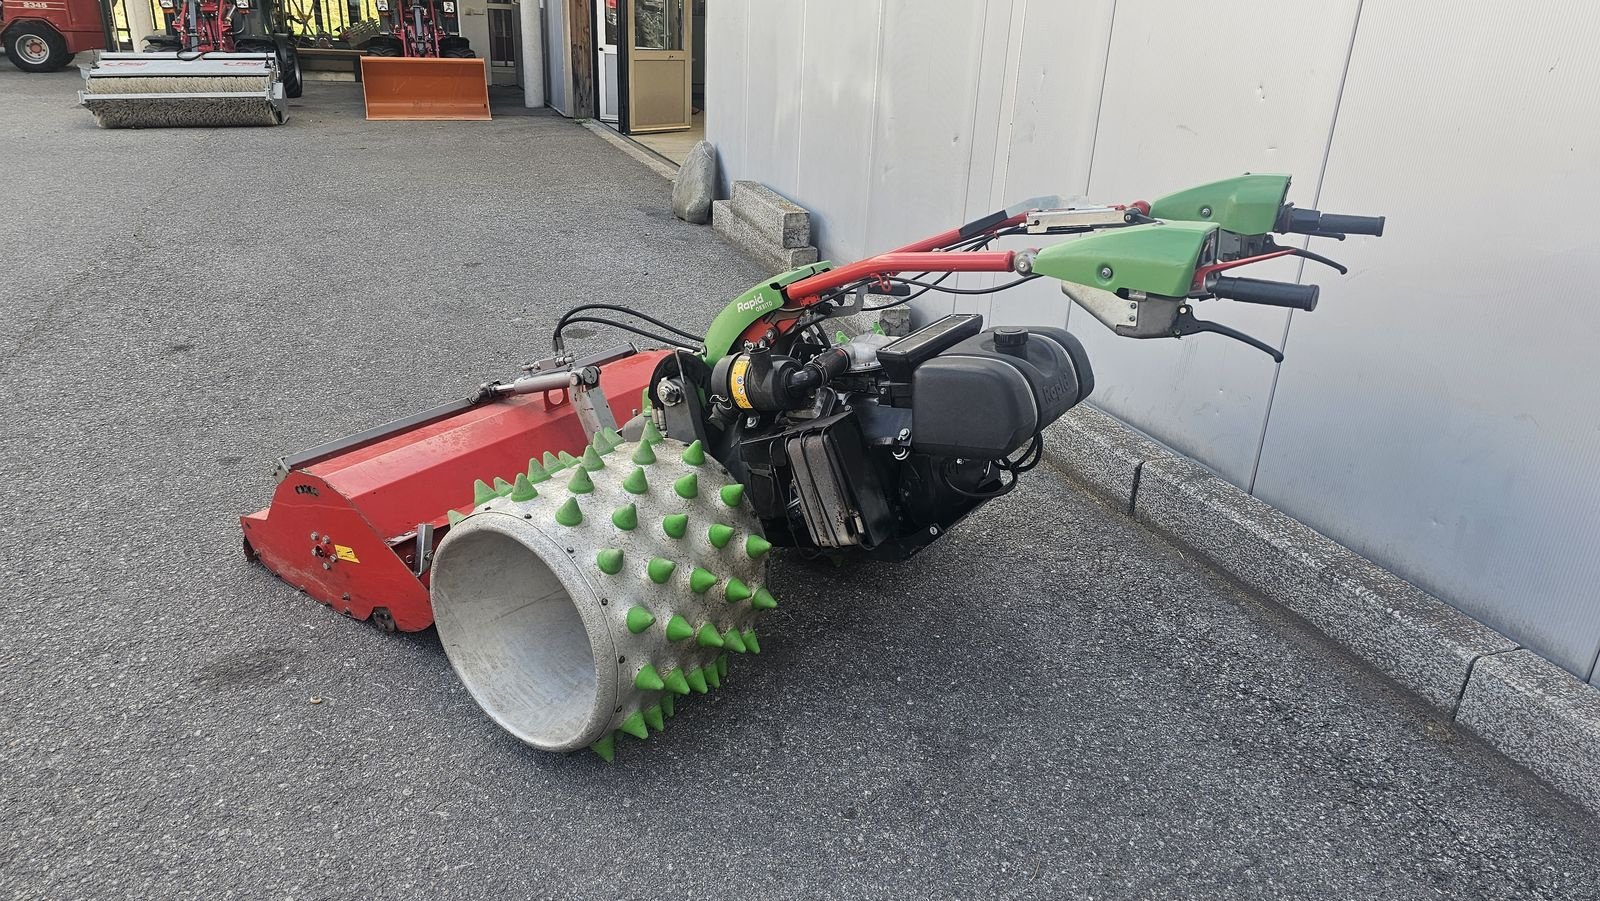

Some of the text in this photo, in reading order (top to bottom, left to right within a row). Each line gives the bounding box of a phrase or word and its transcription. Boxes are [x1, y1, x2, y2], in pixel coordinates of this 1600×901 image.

[737, 293, 764, 313] Rapid
[755, 300, 773, 312] ORBITO
[1043, 373, 1068, 404] Rapid
